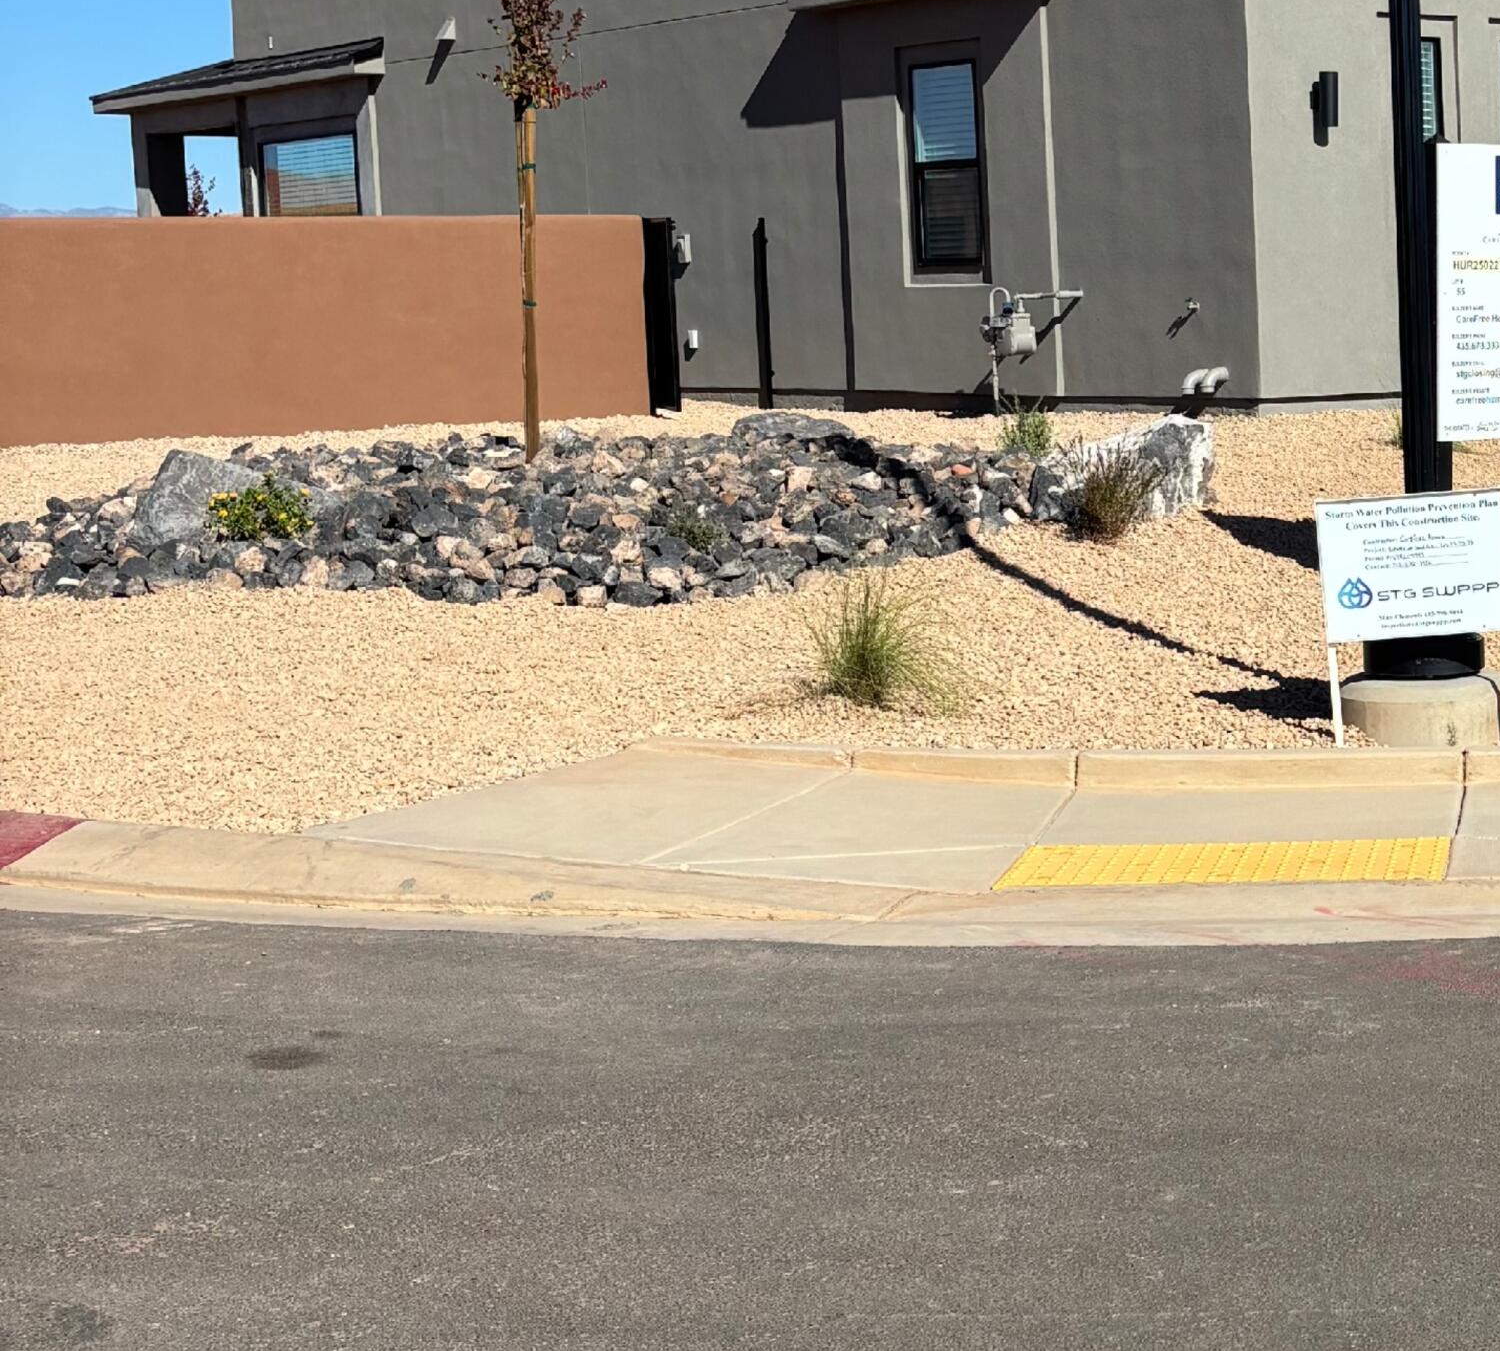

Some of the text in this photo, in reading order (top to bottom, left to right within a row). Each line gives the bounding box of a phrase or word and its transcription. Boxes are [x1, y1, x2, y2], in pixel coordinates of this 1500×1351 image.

[1325, 499, 1499, 519] Storm Water Pollution Prevention Plan
[1345, 521, 1377, 531] Covers
[1380, 519, 1399, 529] This
[1401, 515, 1459, 527] Construction
[1377, 581, 1500, 602] STG SWPPP
